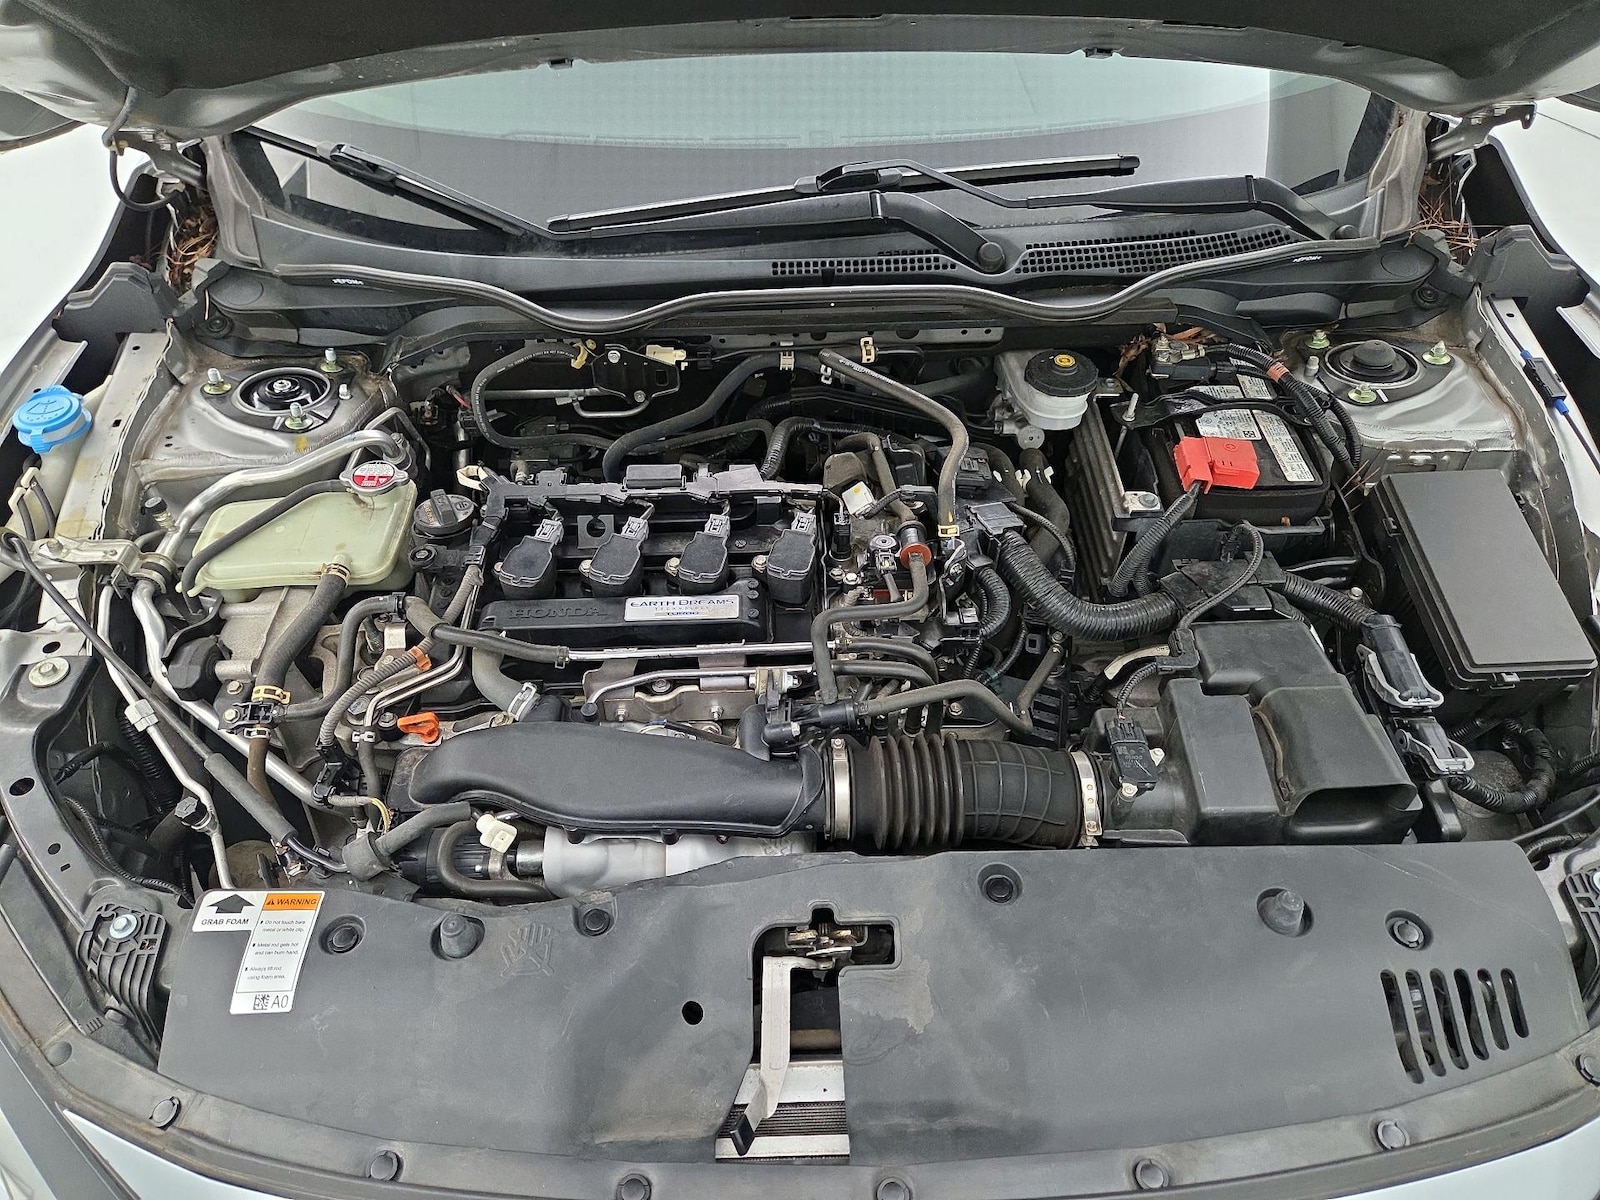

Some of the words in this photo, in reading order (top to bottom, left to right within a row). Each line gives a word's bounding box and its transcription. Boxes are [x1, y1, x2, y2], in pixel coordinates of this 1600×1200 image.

[509, 606, 608, 619] HONDA
[201, 918, 224, 926] GRAB
[271, 995, 289, 1008] A0
